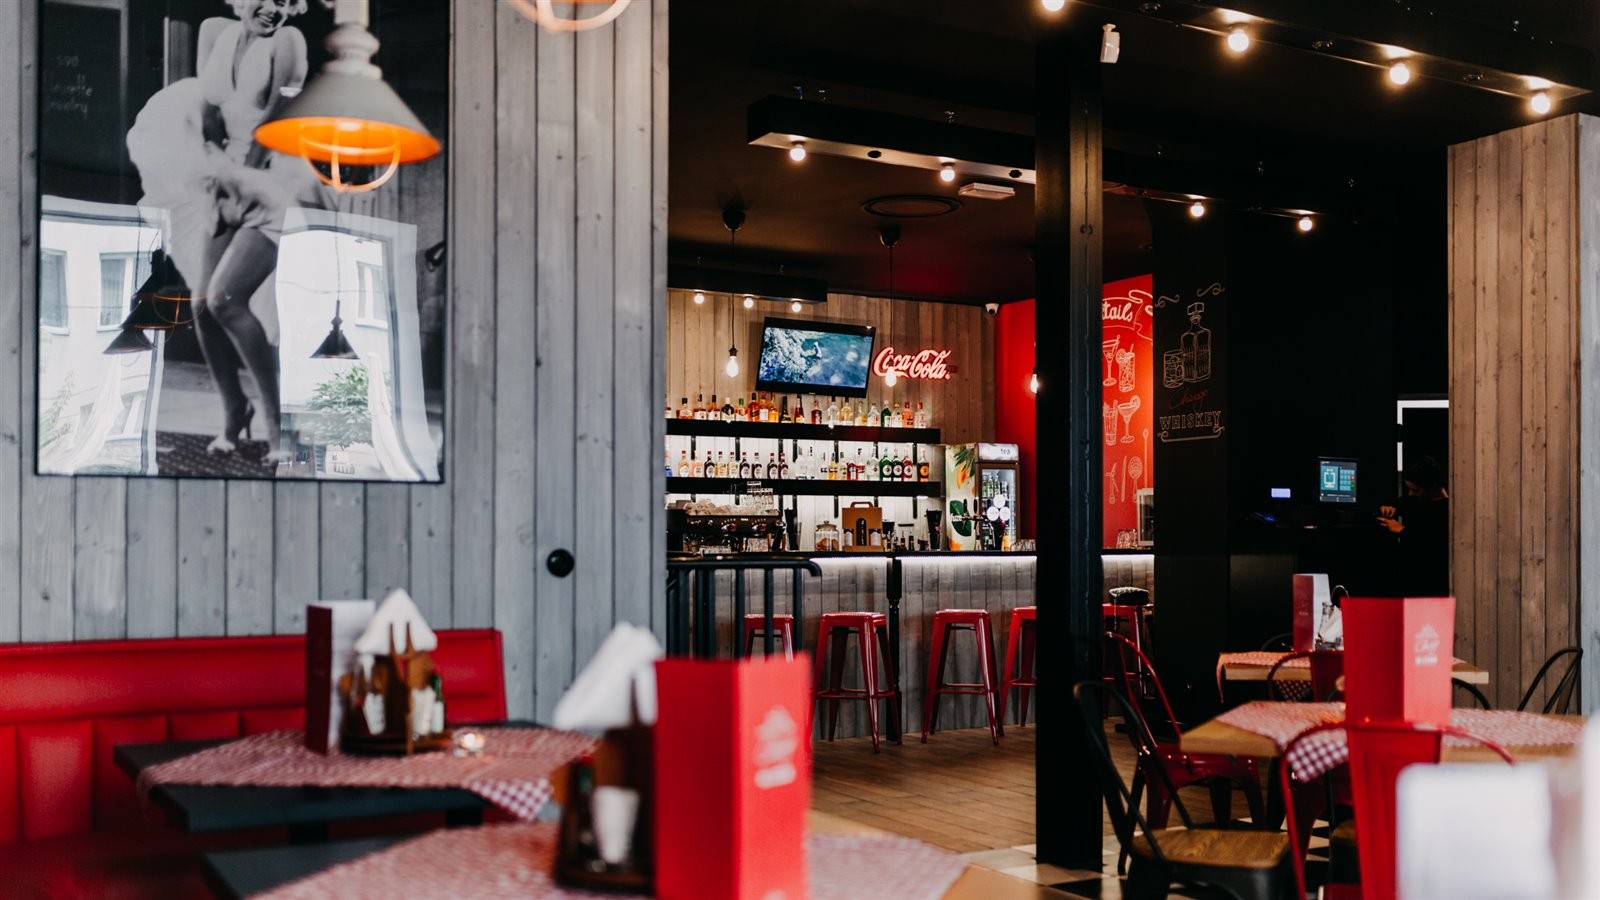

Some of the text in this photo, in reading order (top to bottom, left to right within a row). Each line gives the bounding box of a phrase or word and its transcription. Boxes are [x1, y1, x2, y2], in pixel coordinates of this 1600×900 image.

[1102, 301, 1133, 322] tails
[873, 347, 951, 380] Coca-Cola
[1159, 410, 1222, 430] WHISKEY
